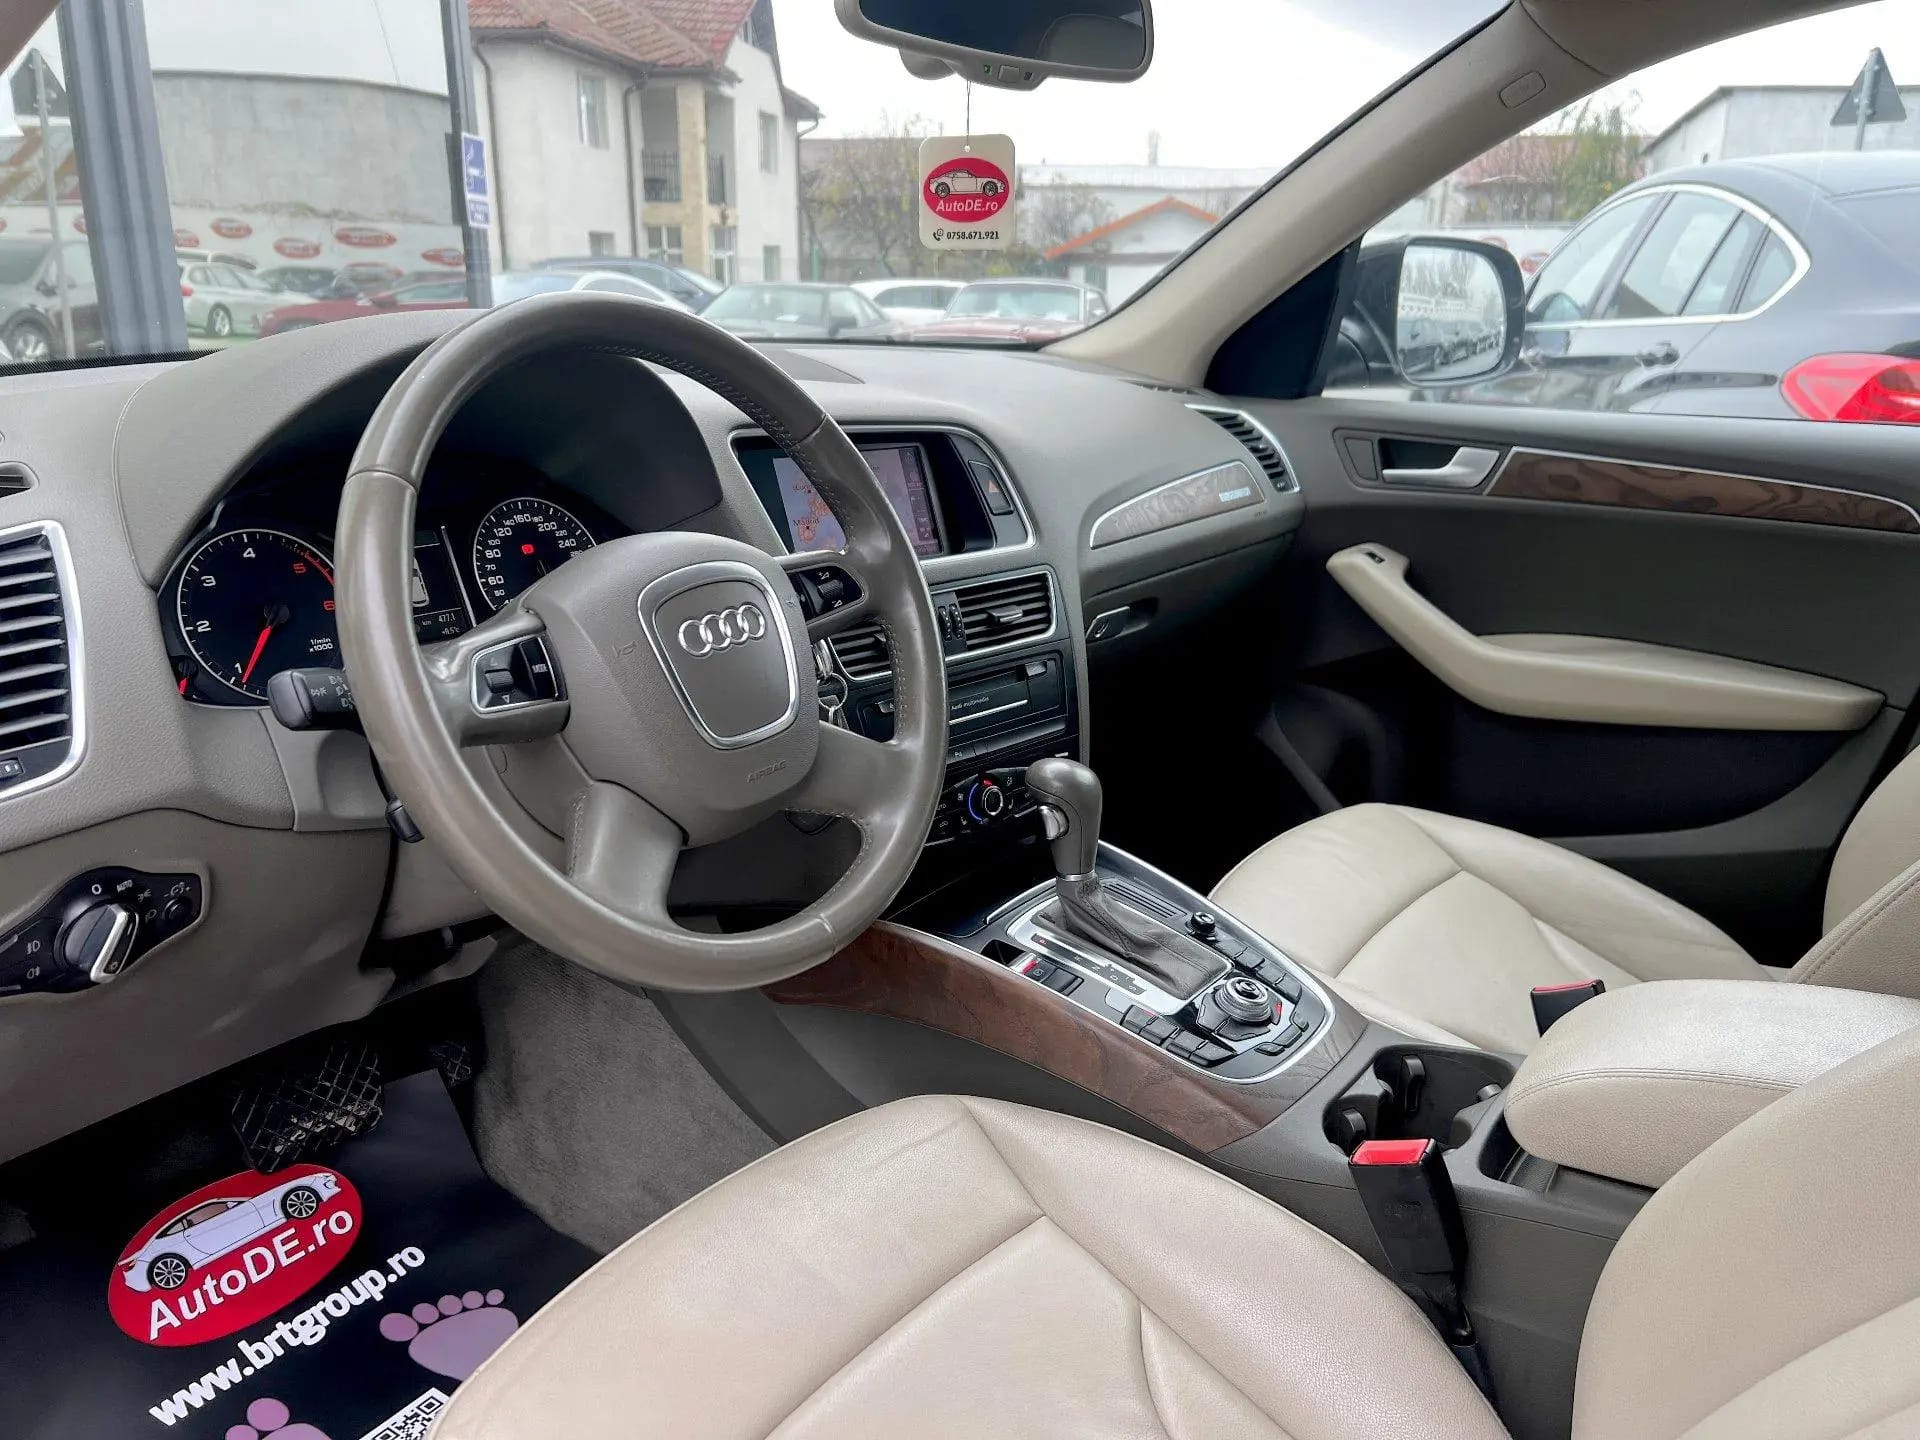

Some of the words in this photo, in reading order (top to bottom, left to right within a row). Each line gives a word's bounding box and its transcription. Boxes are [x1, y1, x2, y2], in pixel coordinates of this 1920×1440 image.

[936, 199, 998, 212] AutoDE.ro
[946, 231, 1000, 240] 0758.671.921
[503, 518, 516, 526] 140
[513, 514, 531, 524] 160
[494, 527, 512, 537] 120
[538, 522, 557, 532] 200
[558, 539, 577, 549] 240
[243, 548, 256, 558] 4
[485, 549, 501, 558] 80
[294, 563, 306, 573] 5
[200, 575, 216, 587] 3
[488, 576, 504, 585] 60
[323, 600, 336, 611] 6
[196, 620, 212, 633] 2
[310, 637, 332, 646] 1/min
[309, 643, 334, 653] x1000
[234, 662, 243, 674] 1
[149, 1210, 353, 1341] AutoDE.ro
[149, 1246, 425, 1426] www.brtgroup.ro
